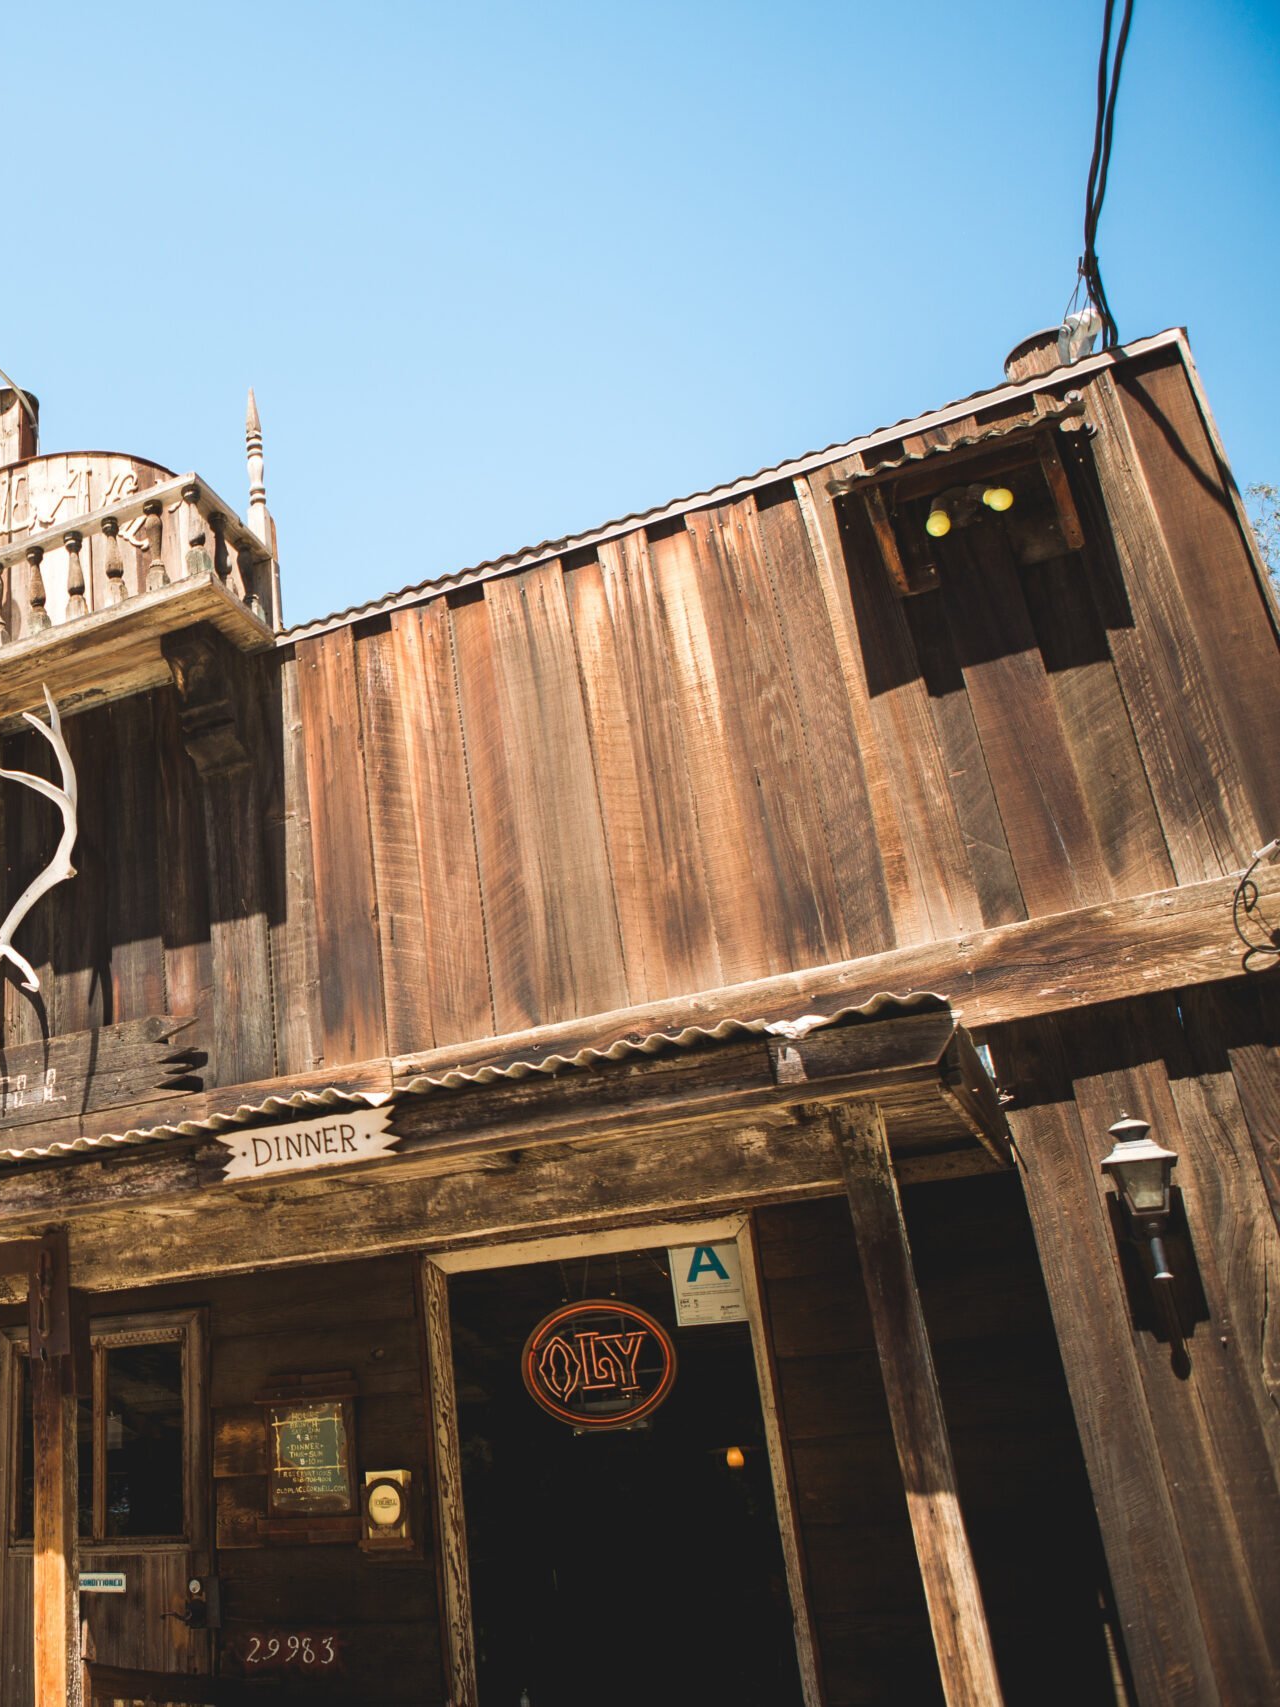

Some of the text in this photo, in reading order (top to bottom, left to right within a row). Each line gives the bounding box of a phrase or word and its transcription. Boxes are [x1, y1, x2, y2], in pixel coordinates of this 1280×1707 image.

[251, 1124, 358, 1168] DINNER
[686, 1246, 731, 1283] A
[538, 1331, 648, 1402] OLY
[80, 1578, 123, 1587] CONDITIONED
[246, 1635, 336, 1665] 29983
